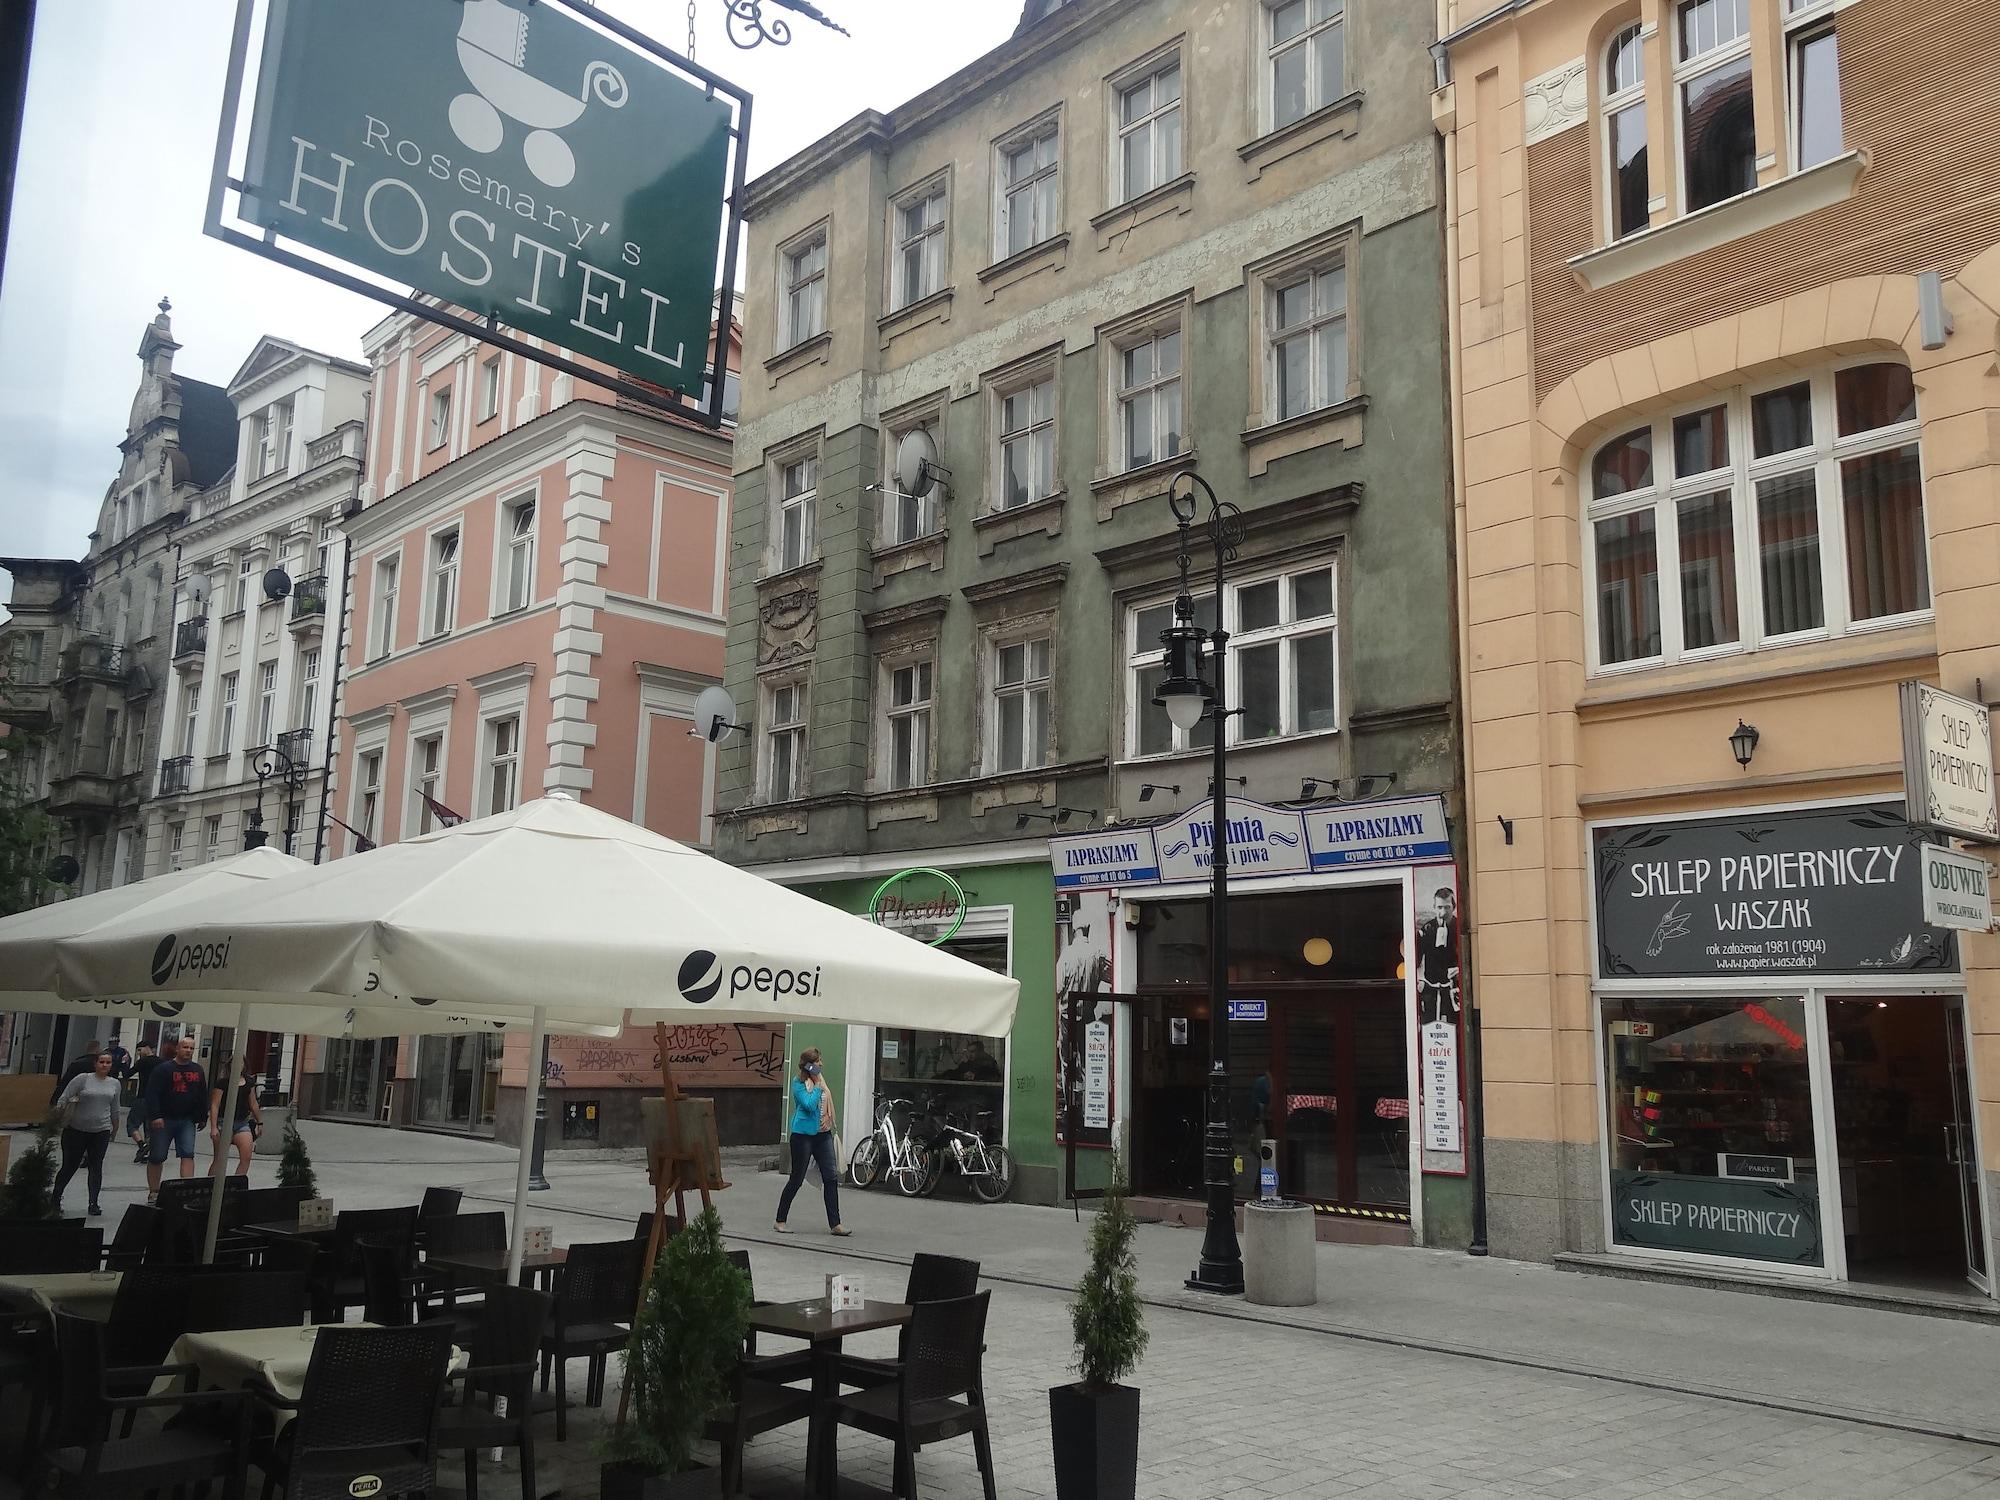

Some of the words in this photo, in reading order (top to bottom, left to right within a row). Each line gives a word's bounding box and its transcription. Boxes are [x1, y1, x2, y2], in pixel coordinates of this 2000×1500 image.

[361, 114, 642, 266] Rosemary's
[278, 135, 684, 369] HOSTEL
[1941, 714, 1970, 750] SKLEP
[1930, 749, 1987, 793] PAPIERNICZY
[1189, 816, 1265, 847] Pijlnia
[1326, 814, 1424, 843] ZAPRASZAMY
[1066, 843, 1138, 867] ZAPRASZAMY
[1232, 848, 1237, 864] i
[1239, 846, 1269, 866] piwa
[1345, 849, 1371, 862] czynne
[1372, 848, 1384, 859] od
[1384, 846, 1394, 858] 10
[1396, 845, 1406, 857] do
[1408, 845, 1415, 856] 5
[1080, 875, 1100, 884] czynne
[1101, 873, 1108, 881] od
[1109, 872, 1117, 881] 10
[1118, 871, 1126, 880] do
[1127, 870, 1132, 880] 5
[1631, 859, 1711, 898] SKLEP
[1720, 845, 1903, 892] PAPIERNICZY
[1929, 860, 1985, 897] OBUWIE
[1060, 903, 1066, 912] 8
[1714, 899, 1812, 931] WASZAK
[176, 935, 232, 979] pepsi
[1706, 943, 1720, 955] rok
[1765, 940, 1789, 954] 1981
[1791, 939, 1826, 955] (1904)
[1716, 954, 1817, 970] www.papier.waszak.pl
[730, 965, 821, 1001] pepsi
[1748, 1165, 1776, 1173] PARKER
[1630, 1199, 1682, 1226] SKLEP
[1687, 1204, 1800, 1238] PAPIERNICZY
